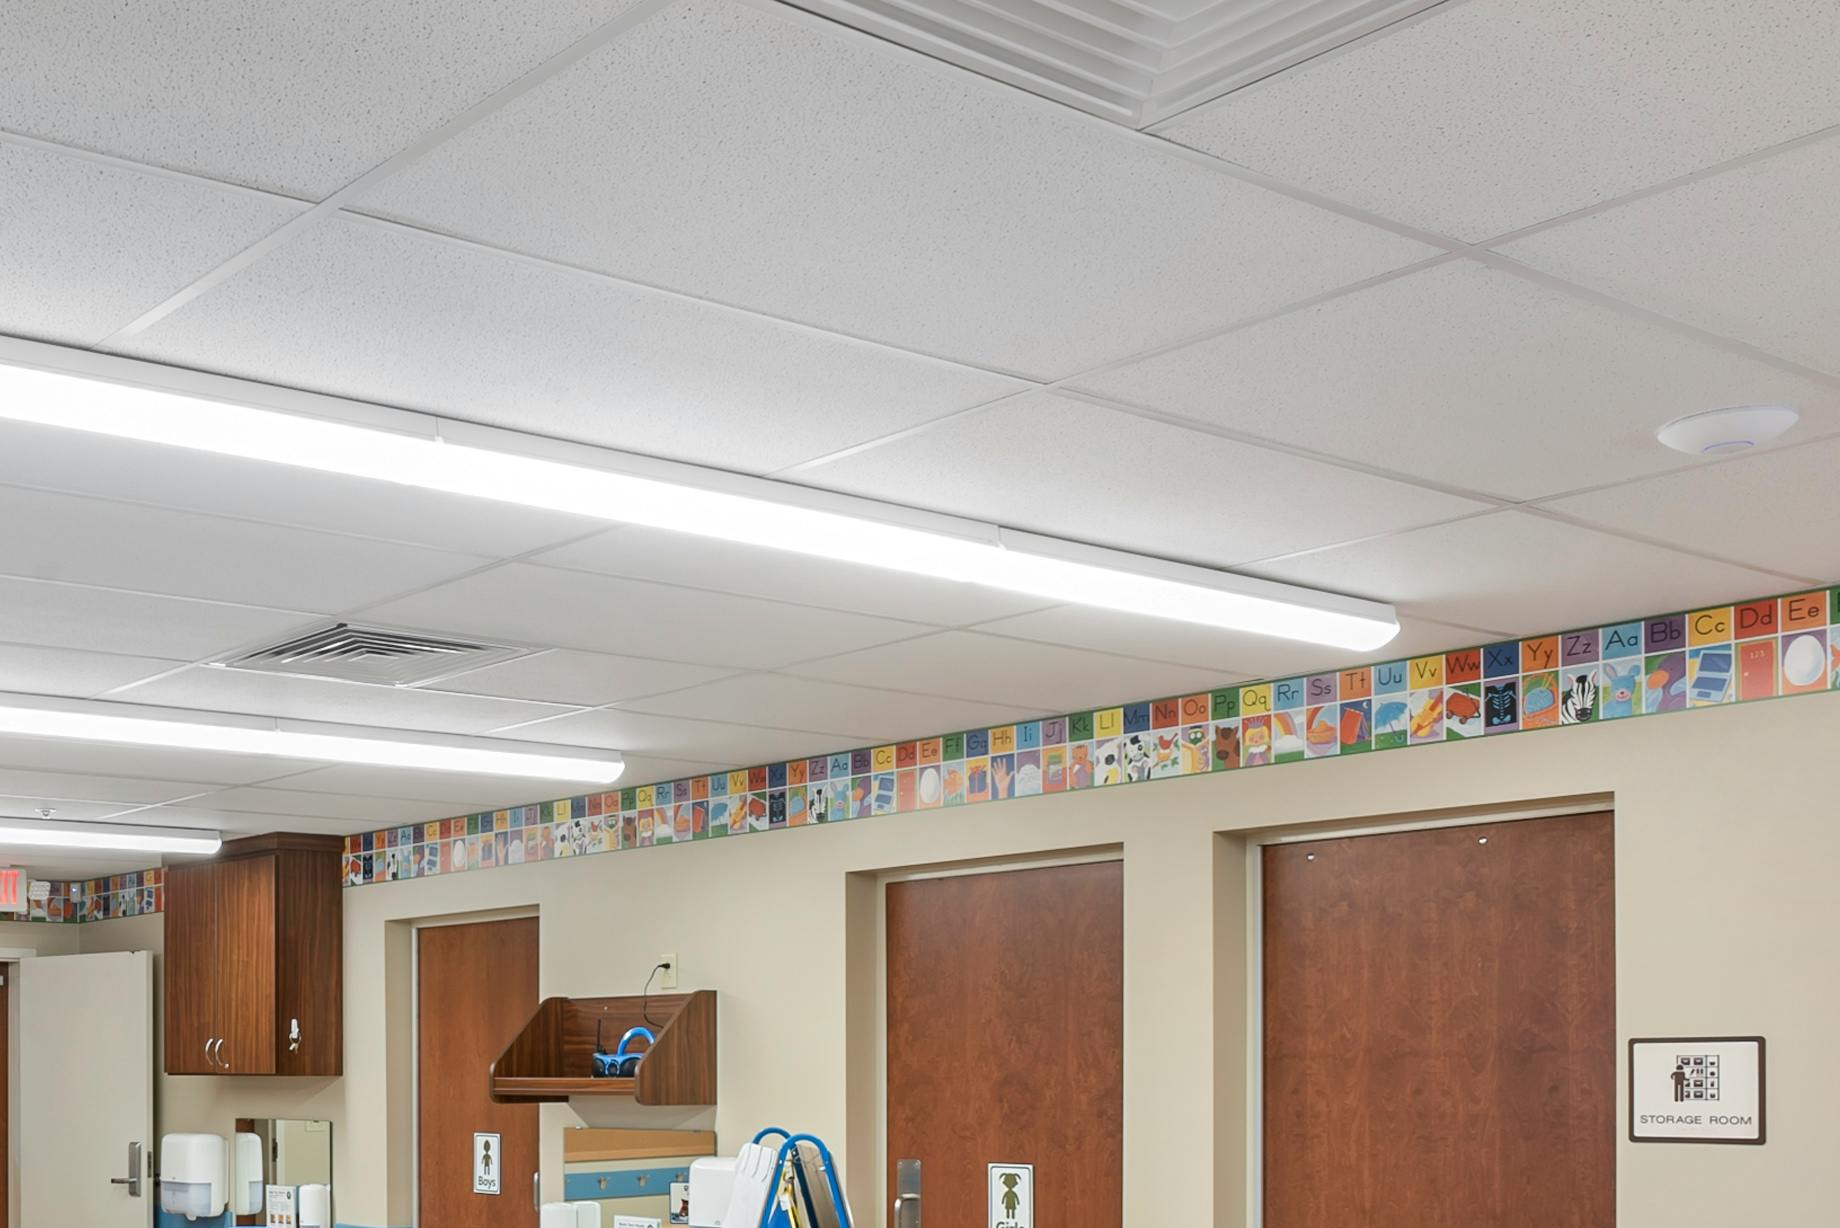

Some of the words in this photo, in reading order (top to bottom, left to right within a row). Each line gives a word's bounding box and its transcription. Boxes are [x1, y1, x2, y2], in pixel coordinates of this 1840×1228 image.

[1740, 607, 1772, 630] Dd
[1788, 598, 1820, 622] Ee
[1650, 622, 1681, 643] Bb
[1694, 614, 1726, 636] Cc
[1566, 635, 1592, 657] Zz
[1605, 629, 1638, 651] Aa
[1447, 654, 1481, 674] Ww
[1487, 648, 1512, 667] Xx
[1526, 641, 1553, 669] Yy
[1378, 666, 1403, 686] Uu
[1415, 660, 1437, 679] Vv
[1311, 678, 1332, 697] Ss
[1345, 672, 1367, 690] Tt
[1242, 689, 1270, 712] Qq
[1277, 683, 1299, 702] Rr
[1154, 704, 1176, 721] Nn
[1183, 699, 1207, 716] Oo
[1214, 694, 1235, 717] Pp
[1099, 713, 1114, 730] Ll
[993, 730, 1012, 745] Hh
[1640, 1114, 1703, 1125] STORAGE
[1709, 1115, 1753, 1126] ROOM
[478, 1175, 496, 1190] Boys
